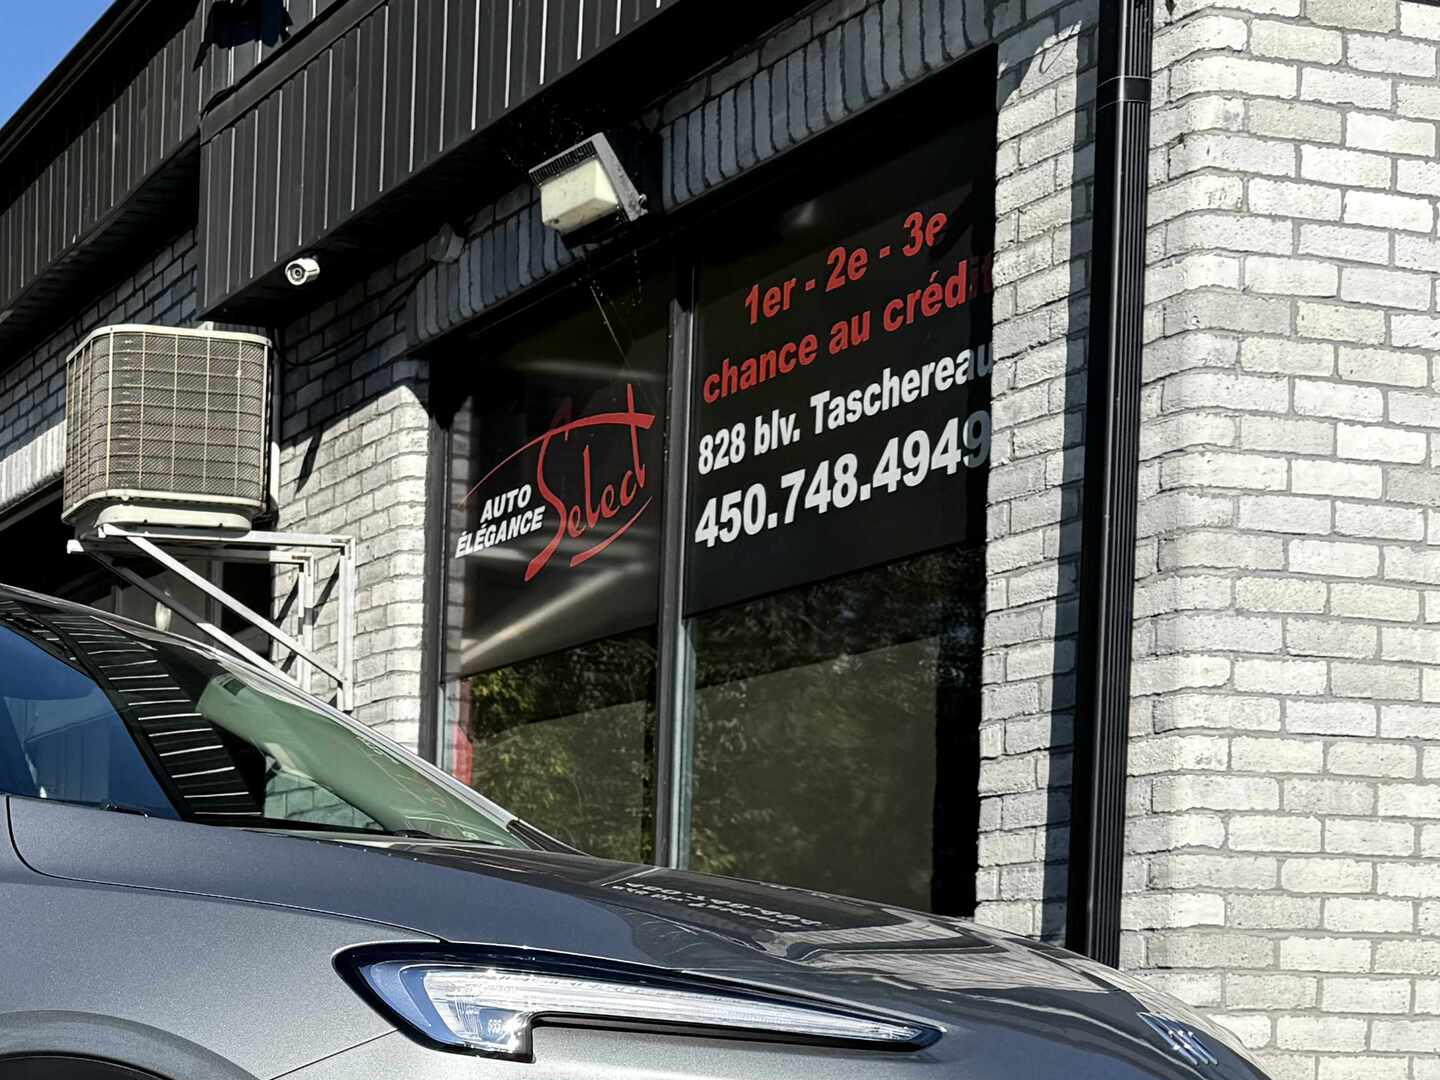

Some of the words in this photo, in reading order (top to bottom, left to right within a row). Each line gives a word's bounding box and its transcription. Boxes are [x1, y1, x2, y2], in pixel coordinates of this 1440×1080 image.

[745, 278, 796, 325] 1er
[804, 278, 816, 292] -
[825, 246, 867, 292] 2e
[879, 246, 891, 259] -
[902, 210, 948, 256] 3e
[698, 422, 746, 476] 828
[754, 408, 801, 456] blv.
[810, 341, 992, 435] Taschereau
[703, 334, 818, 404] chance
[829, 311, 871, 355] au
[480, 484, 532, 523] AUTO
[694, 410, 991, 548] 450.748.4949
[455, 505, 546, 560] ÉLÉGANCE
